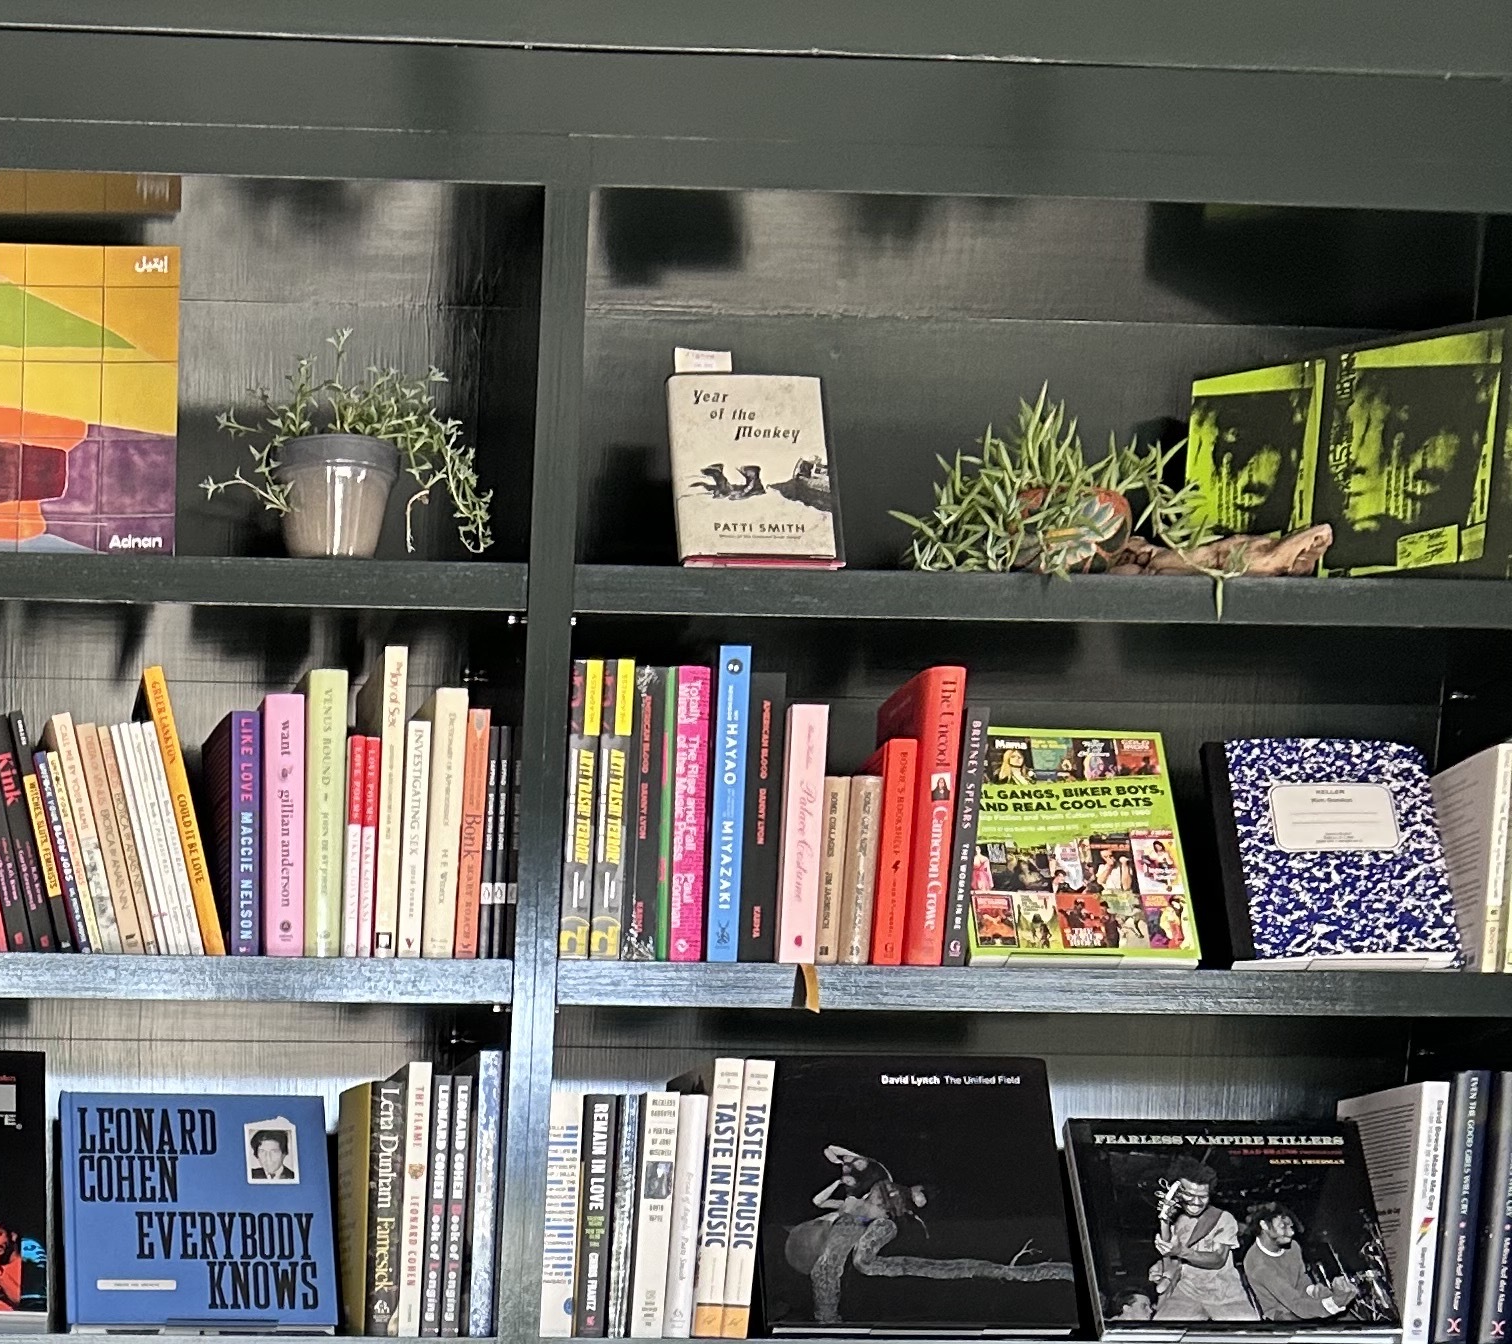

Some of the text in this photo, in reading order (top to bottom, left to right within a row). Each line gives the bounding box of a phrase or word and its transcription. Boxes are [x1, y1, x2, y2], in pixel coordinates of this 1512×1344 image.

[694, 390, 728, 404] Year
[710, 408, 755, 420] of the
[735, 426, 800, 443] Monkey
[109, 535, 162, 548] Adnan
[714, 523, 805, 533] PATTI SMITH
[962, 720, 982, 830] BRITNEY SPEARS
[998, 785, 1164, 801] GANGS, BIKER BOYS,
[278, 720, 294, 907] want gillian anderson
[718, 724, 738, 909] HAYAO MIYAZAKI
[1013, 802, 1057, 812] REAL
[1061, 799, 1107, 810] COOL
[1111, 798, 1153, 807] CATS
[239, 719, 254, 940] LIKE LOVE MAGGIE NELSON
[881, 1074, 1020, 1086] David Lynch The Unified Field
[77, 1107, 217, 1155] LEONARD
[378, 1087, 399, 1209] Lena Dunham
[1093, 1134, 1344, 1146] FEARLESS VAMPIRE KILLERS
[79, 1156, 178, 1202] COHEN
[589, 1103, 609, 1211] REMAIN IN LOVE
[705, 1102, 737, 1248] TASTE IN MUSIC
[136, 1212, 314, 1260] EVERYBODY
[374, 1217, 395, 1291] Famesick
[208, 1261, 319, 1310] KNOWS
